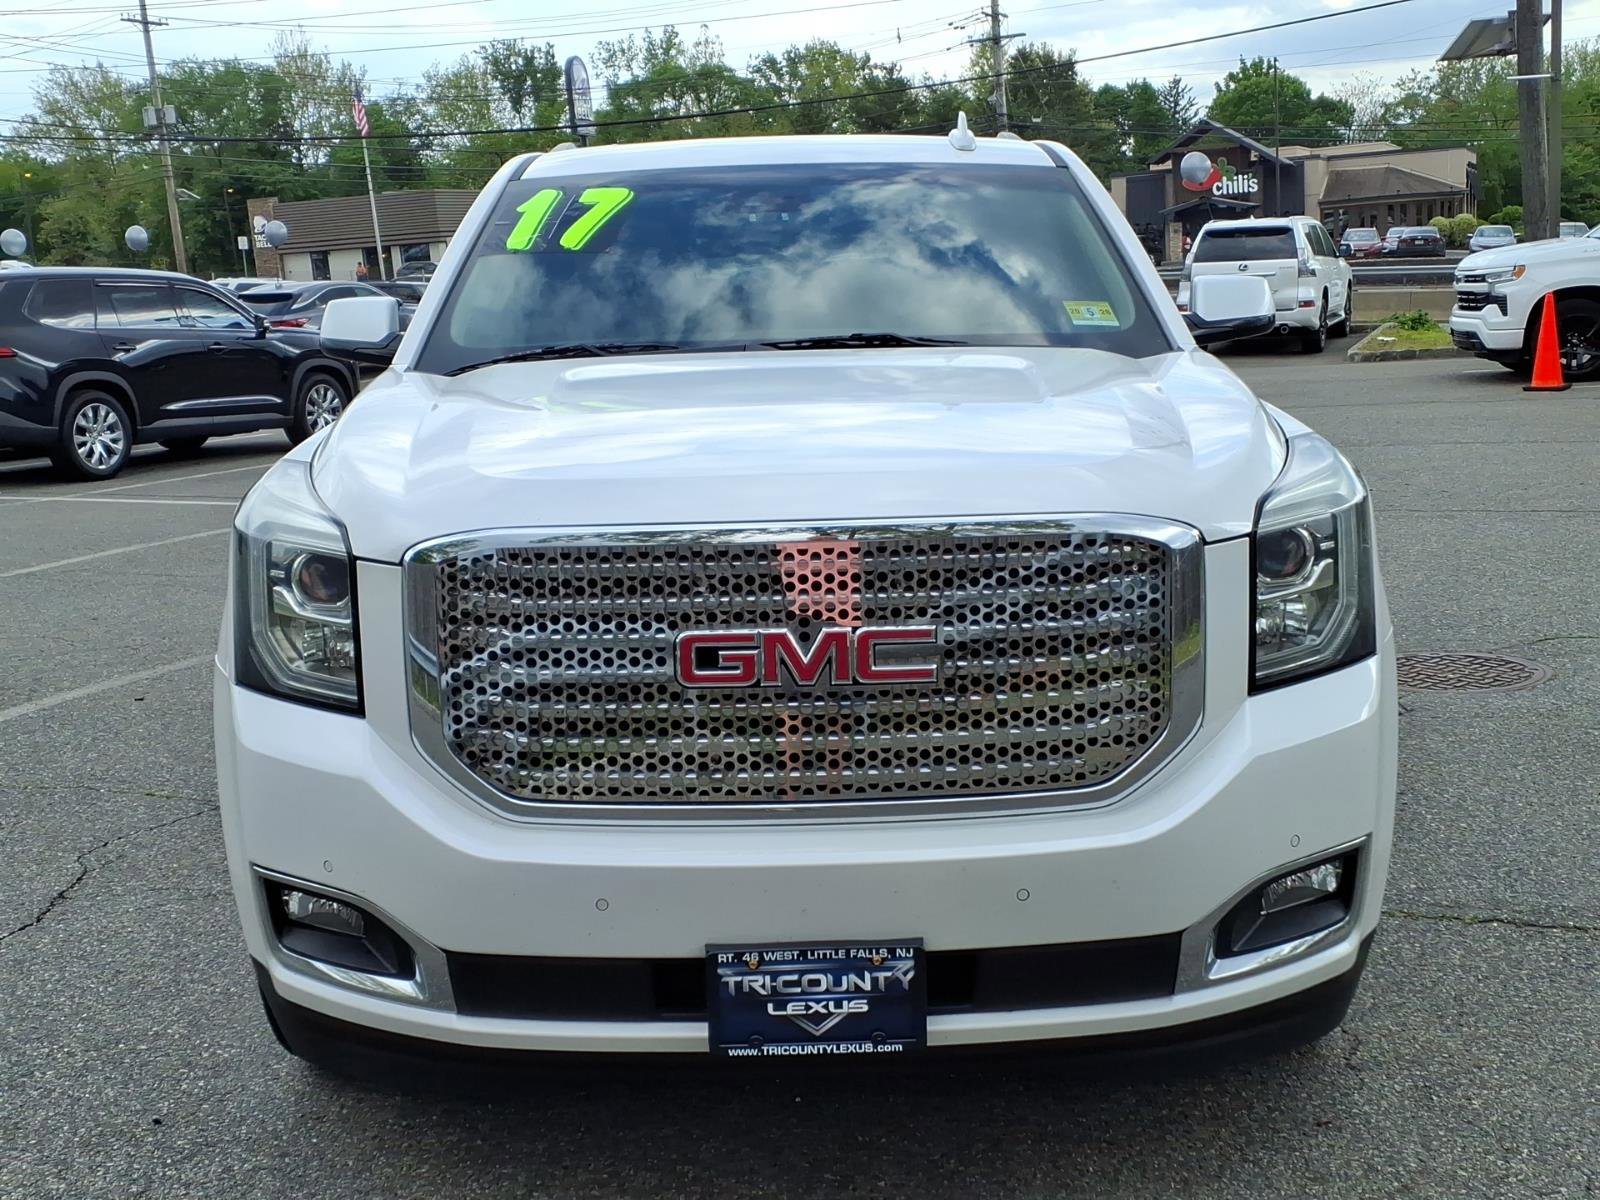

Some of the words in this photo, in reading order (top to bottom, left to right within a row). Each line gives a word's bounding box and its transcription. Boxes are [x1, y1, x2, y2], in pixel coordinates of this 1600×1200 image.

[1212, 173, 1259, 196] chili's
[506, 188, 634, 251] 17
[1086, 306, 1096, 317] 5
[675, 625, 938, 687] GMC
[717, 953, 738, 964] RT.
[742, 952, 759, 962] 46
[763, 951, 803, 961] WEST,
[807, 950, 846, 960] LITTLE
[850, 948, 891, 960] FALLS,
[896, 948, 914, 958] NJ
[721, 969, 915, 997] TRI-COUNTY
[767, 999, 869, 1016] LEXUS
[728, 1043, 903, 1057] www.TRICOUNTYLEXUS.com
